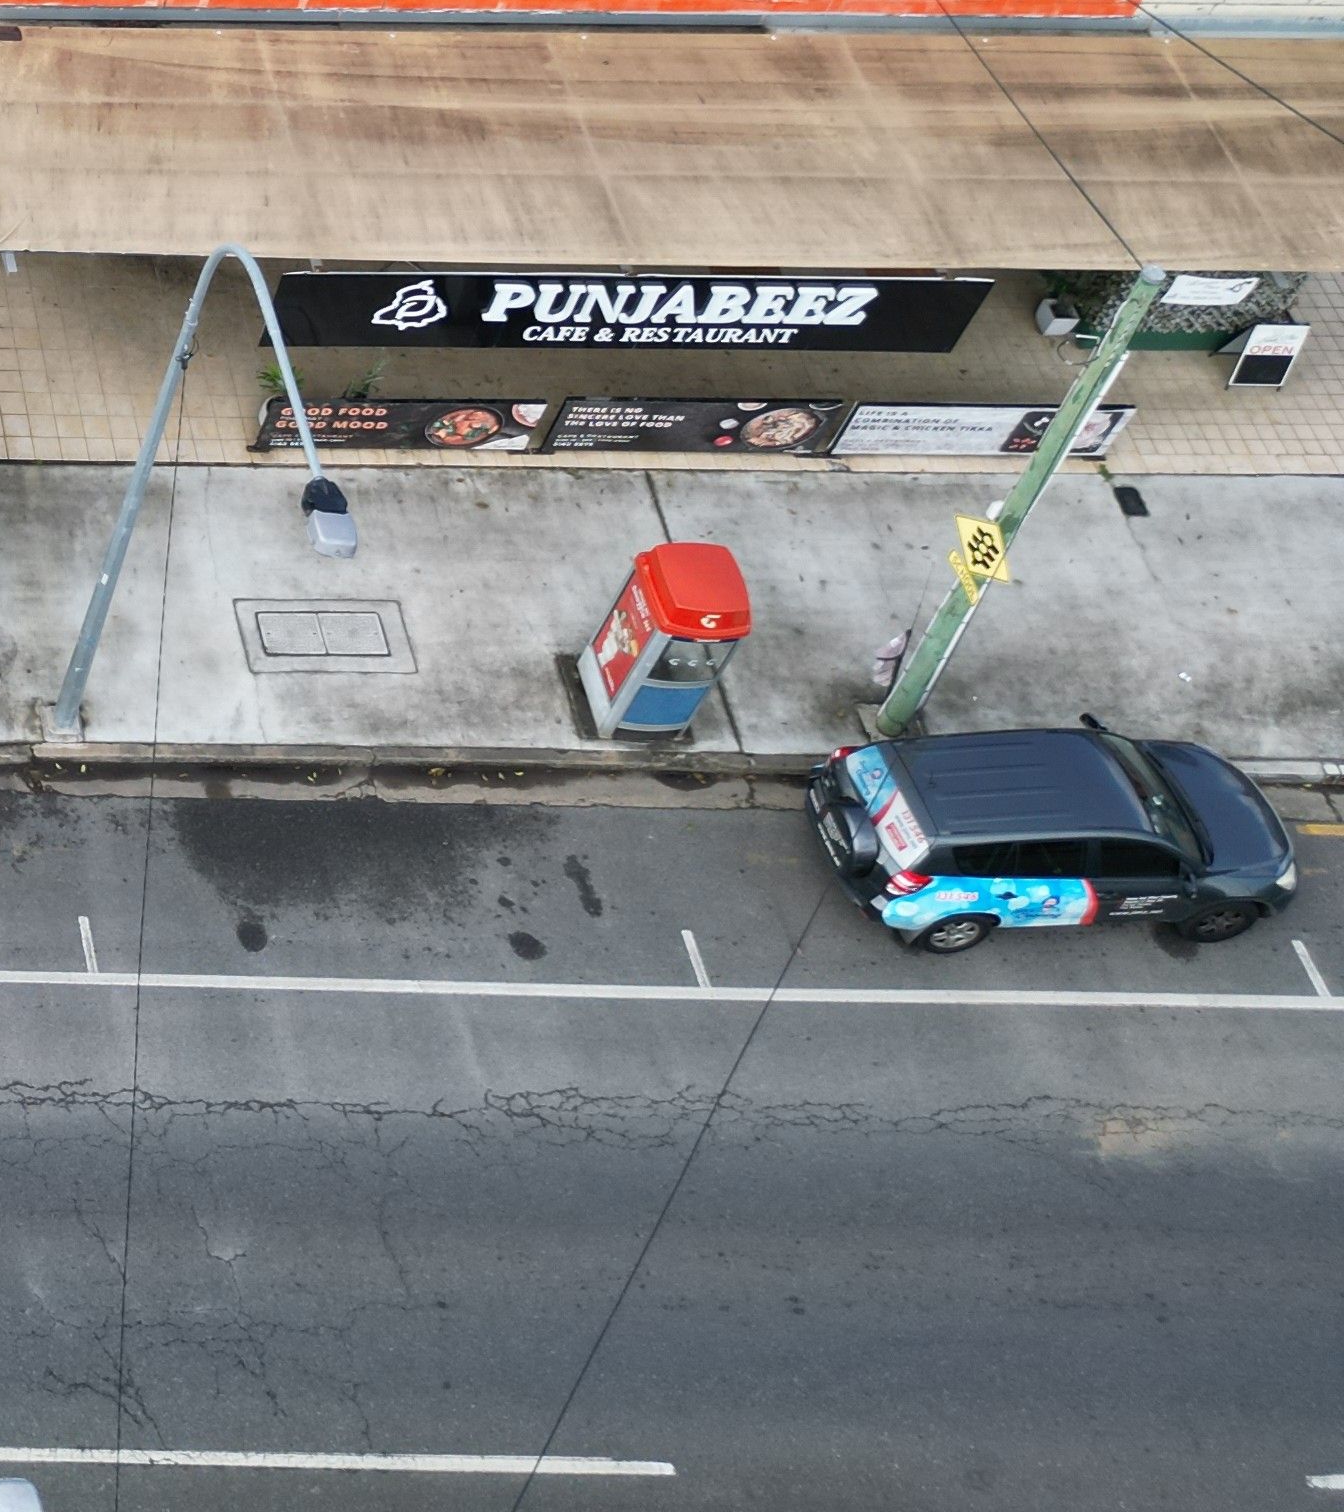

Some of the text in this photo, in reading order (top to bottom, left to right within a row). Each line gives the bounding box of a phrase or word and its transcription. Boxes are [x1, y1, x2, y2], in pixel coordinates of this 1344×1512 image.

[481, 283, 879, 326] PUNJABEEZ
[522, 326, 799, 344] CAFE & RESTAURANT
[1249, 344, 1294, 355] OPEN
[280, 407, 389, 417] GOD FOOD
[332, 420, 389, 430] MOOD
